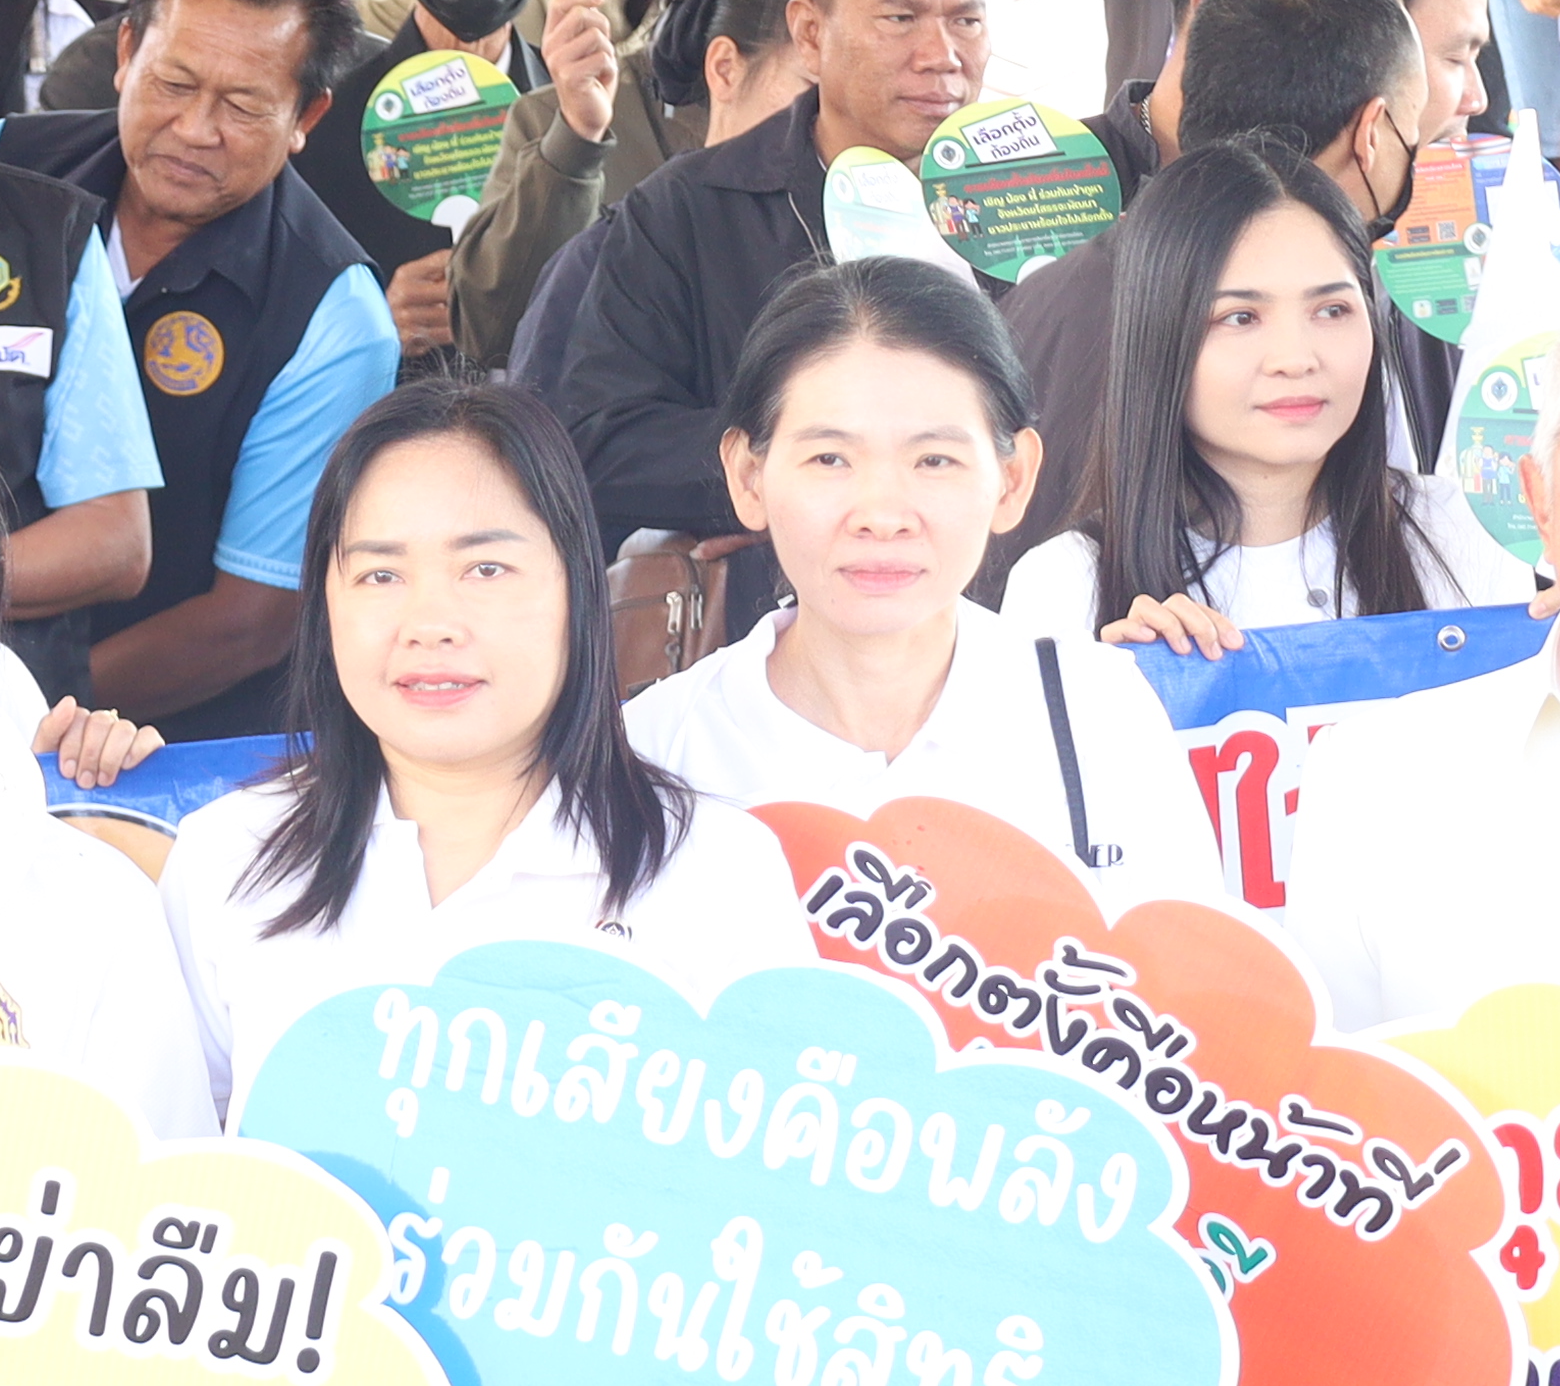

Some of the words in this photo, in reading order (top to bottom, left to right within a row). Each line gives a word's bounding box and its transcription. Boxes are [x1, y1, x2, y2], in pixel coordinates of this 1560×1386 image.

[972, 112, 1037, 146] เลือกตั้ง
[990, 133, 1040, 160] ท้องถิ่น
[371, 986, 1140, 1249] ทุกเสียงคือพลัง
[805, 843, 1462, 1244] เลือกตั้งคือหน้าที่
